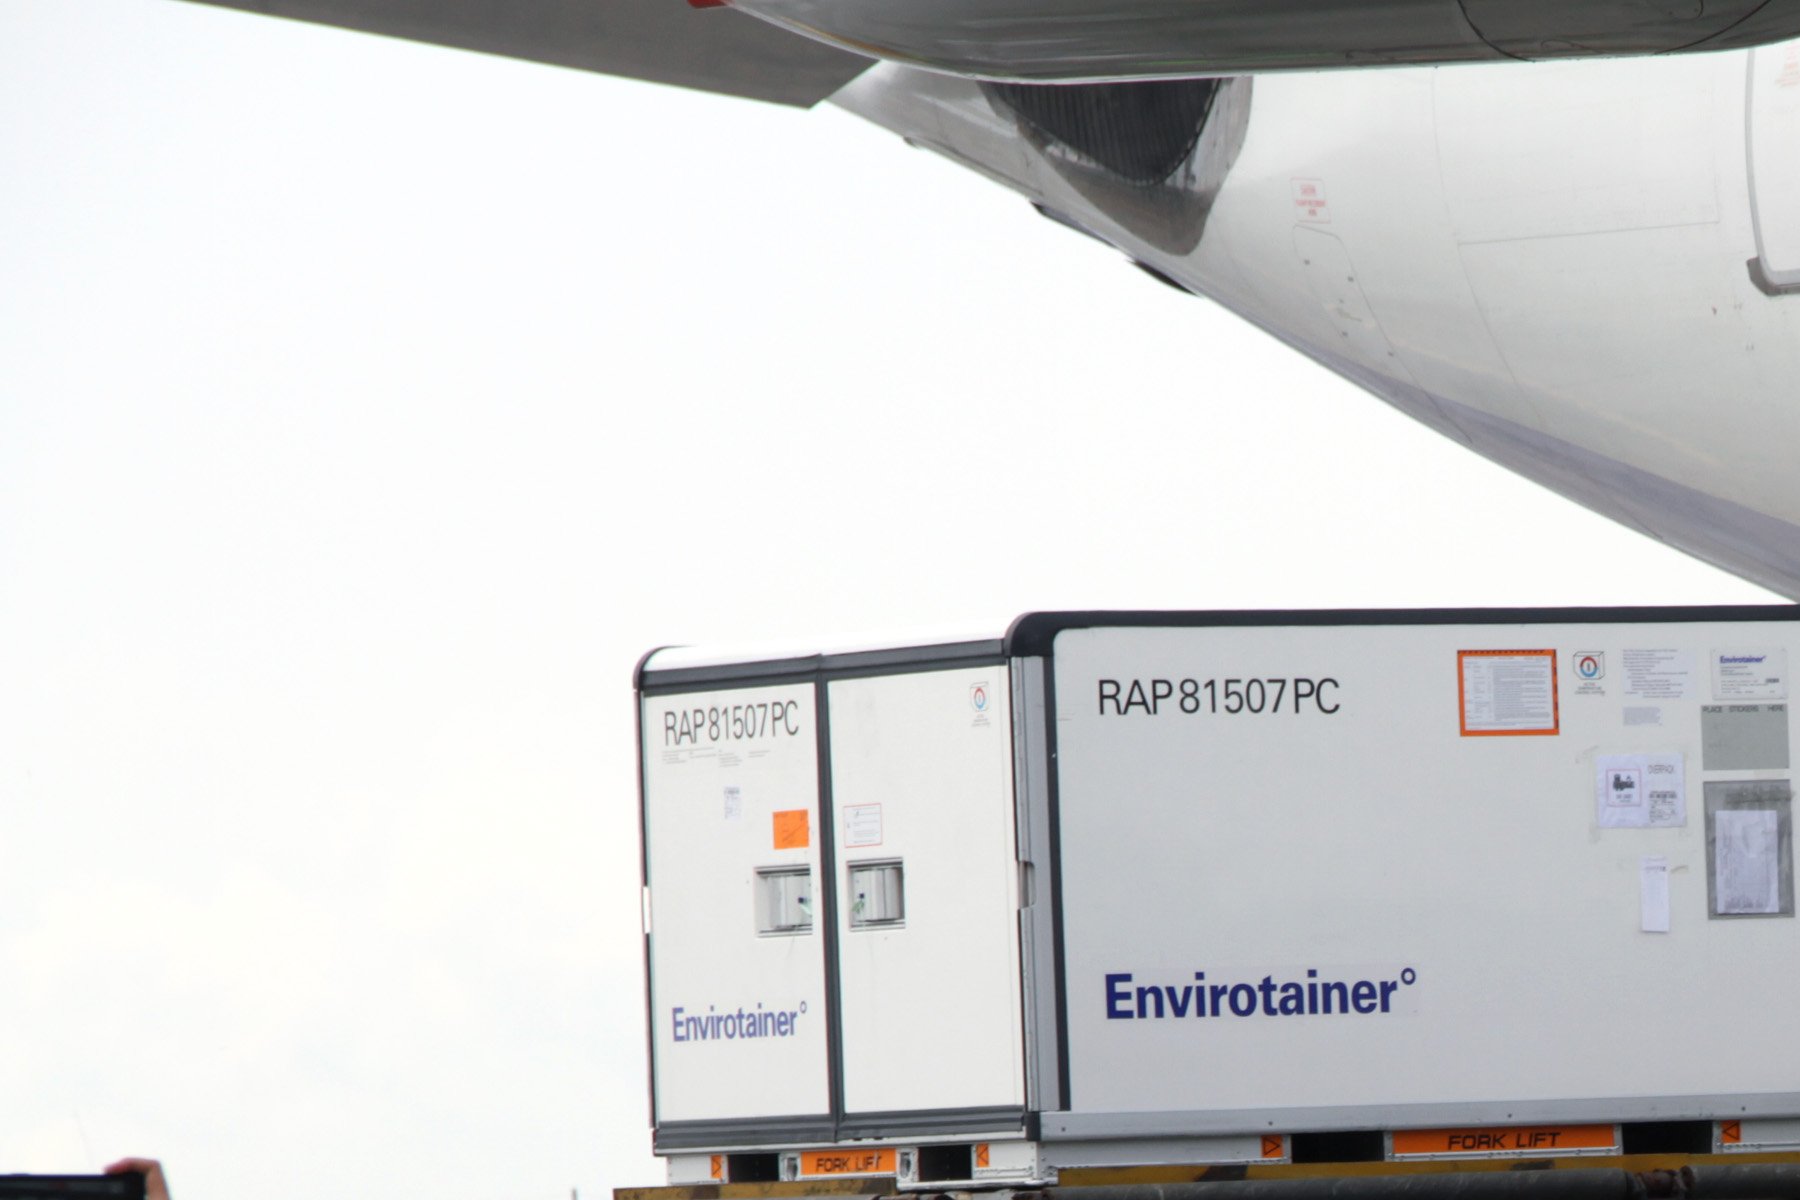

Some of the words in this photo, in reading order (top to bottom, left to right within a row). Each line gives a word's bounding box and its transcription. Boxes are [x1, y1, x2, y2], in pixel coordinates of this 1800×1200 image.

[1702, 705, 1723, 713] PLACE
[1728, 704, 1759, 713] STICKERS
[1447, 1133, 1506, 1151] FORK
[1515, 1131, 1561, 1148] LIFT
[816, 1157, 850, 1173] FORK
[855, 1154, 882, 1171] LIFT
